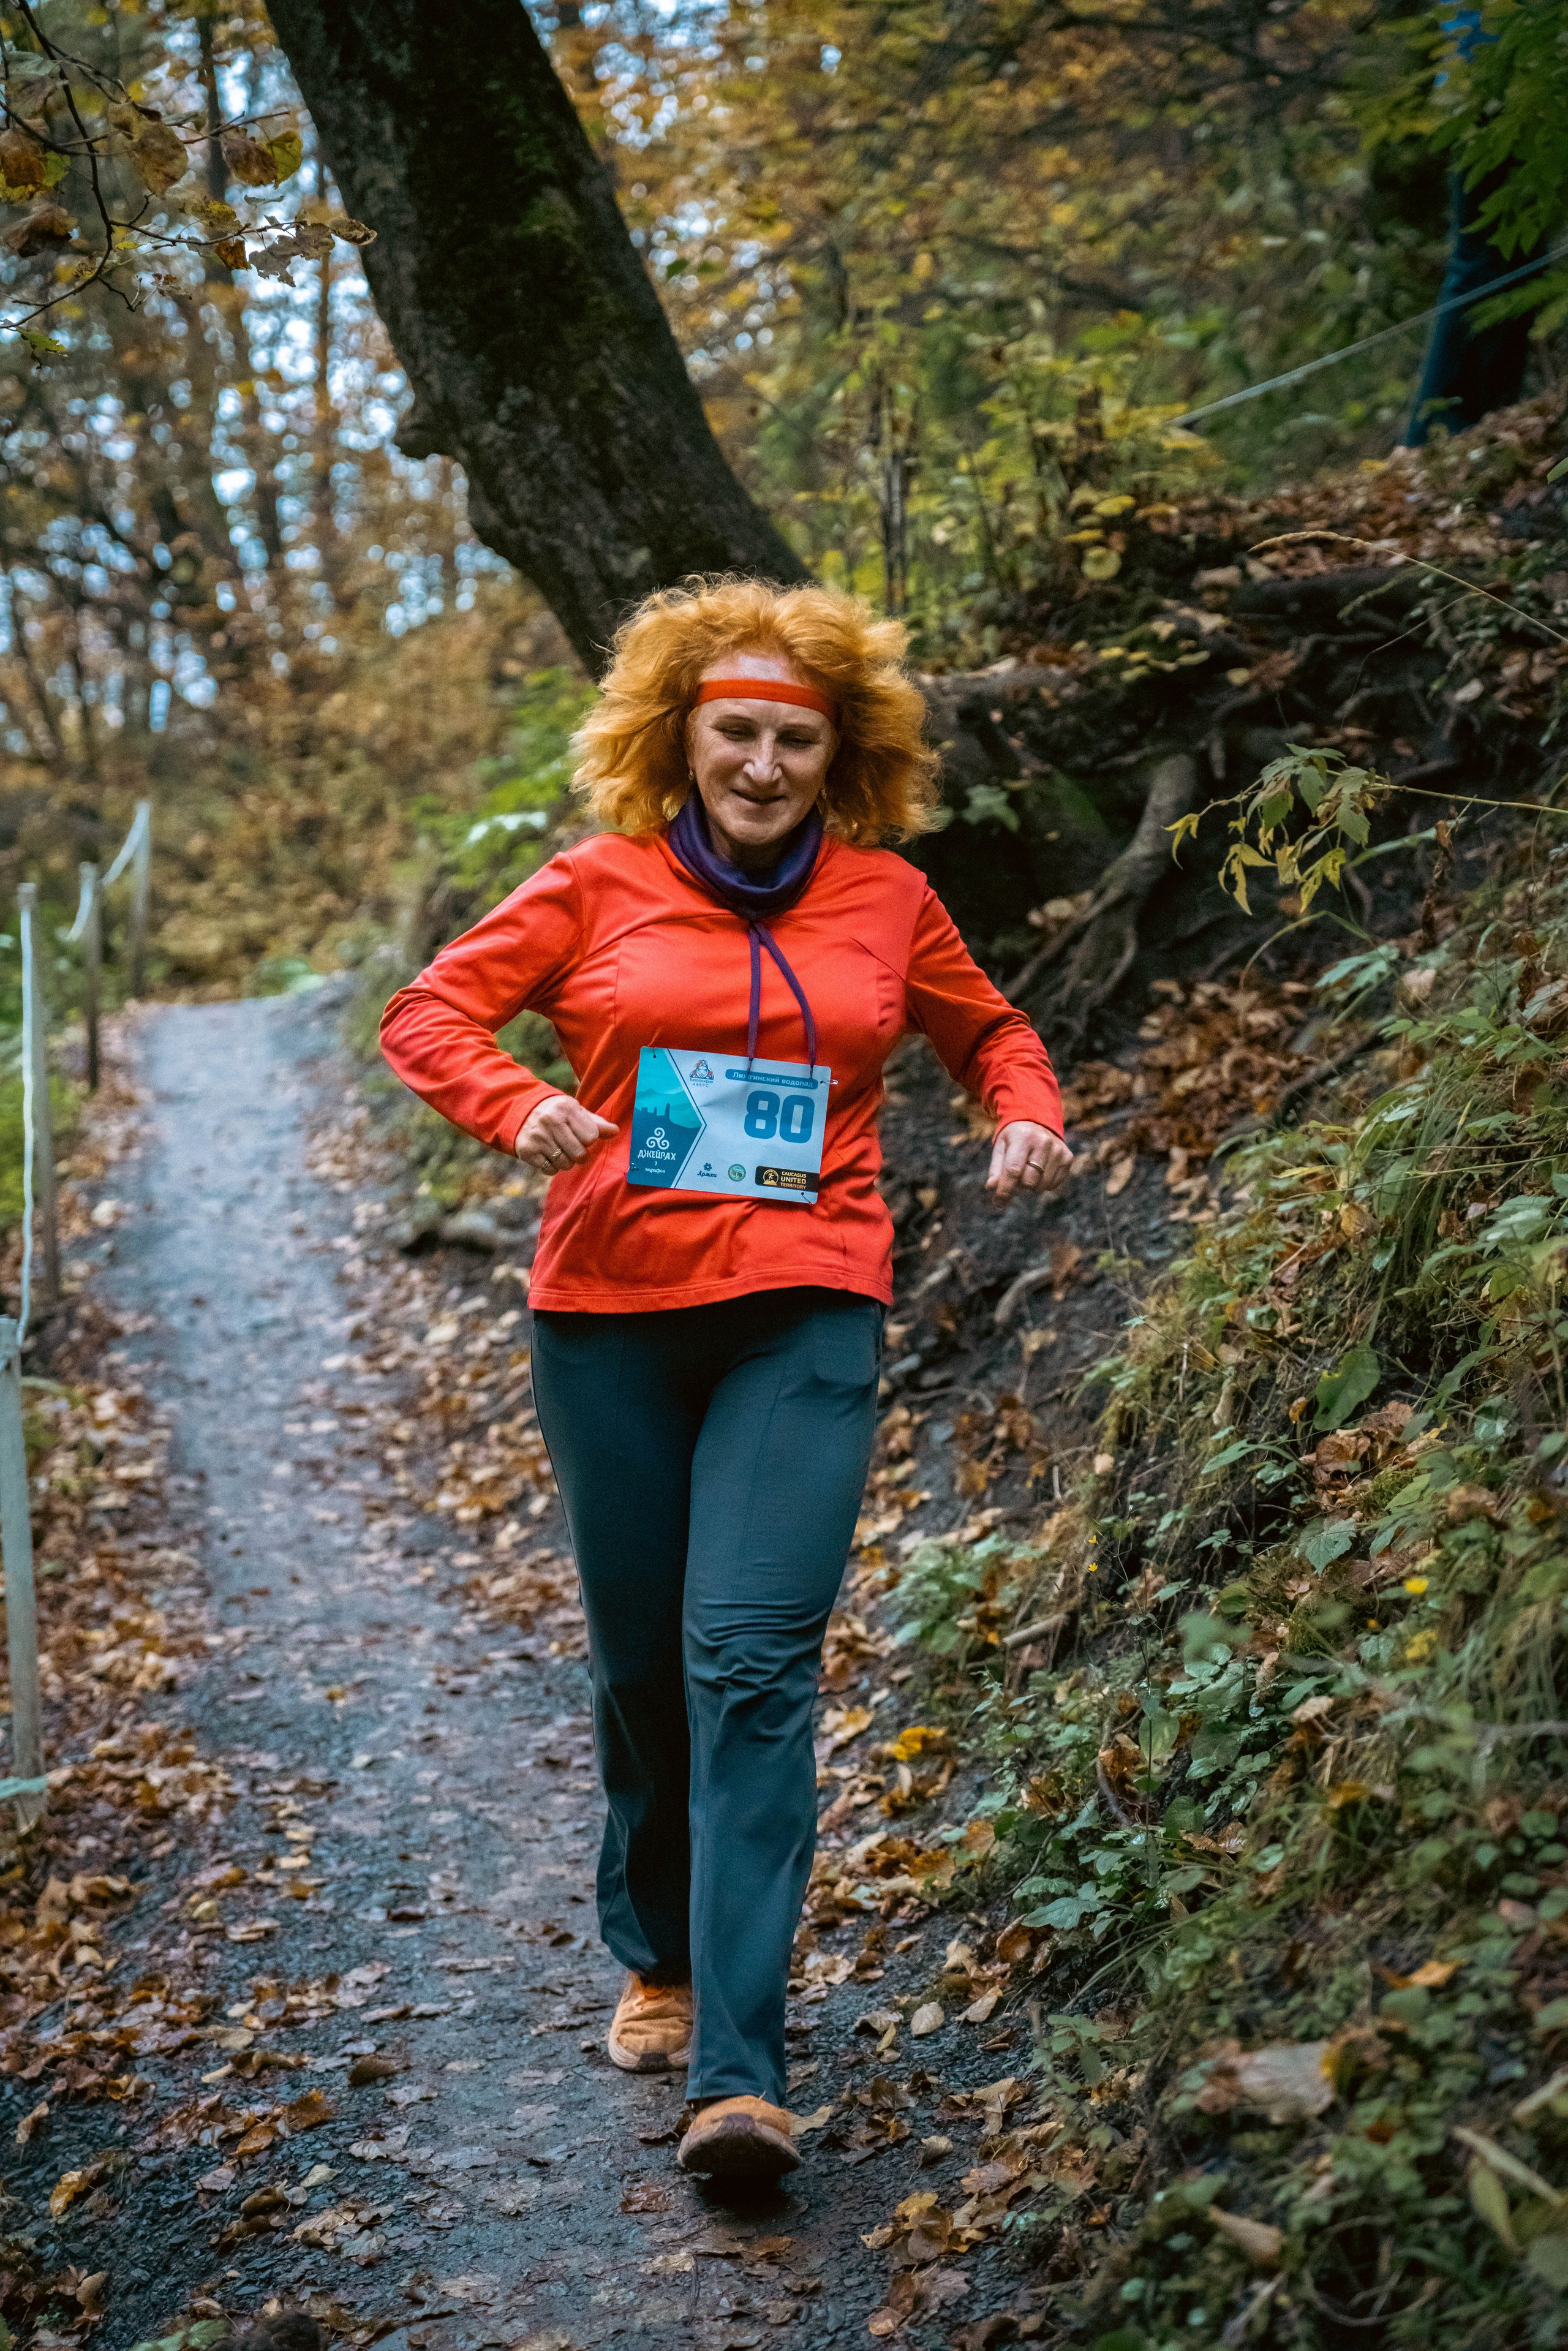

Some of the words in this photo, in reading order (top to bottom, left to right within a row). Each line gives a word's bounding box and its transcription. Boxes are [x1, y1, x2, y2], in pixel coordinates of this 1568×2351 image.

[782, 1078, 813, 1088] водопад
[744, 1090, 815, 1144] 80
[638, 1150, 676, 1160] ДЖЕЙРАХ
